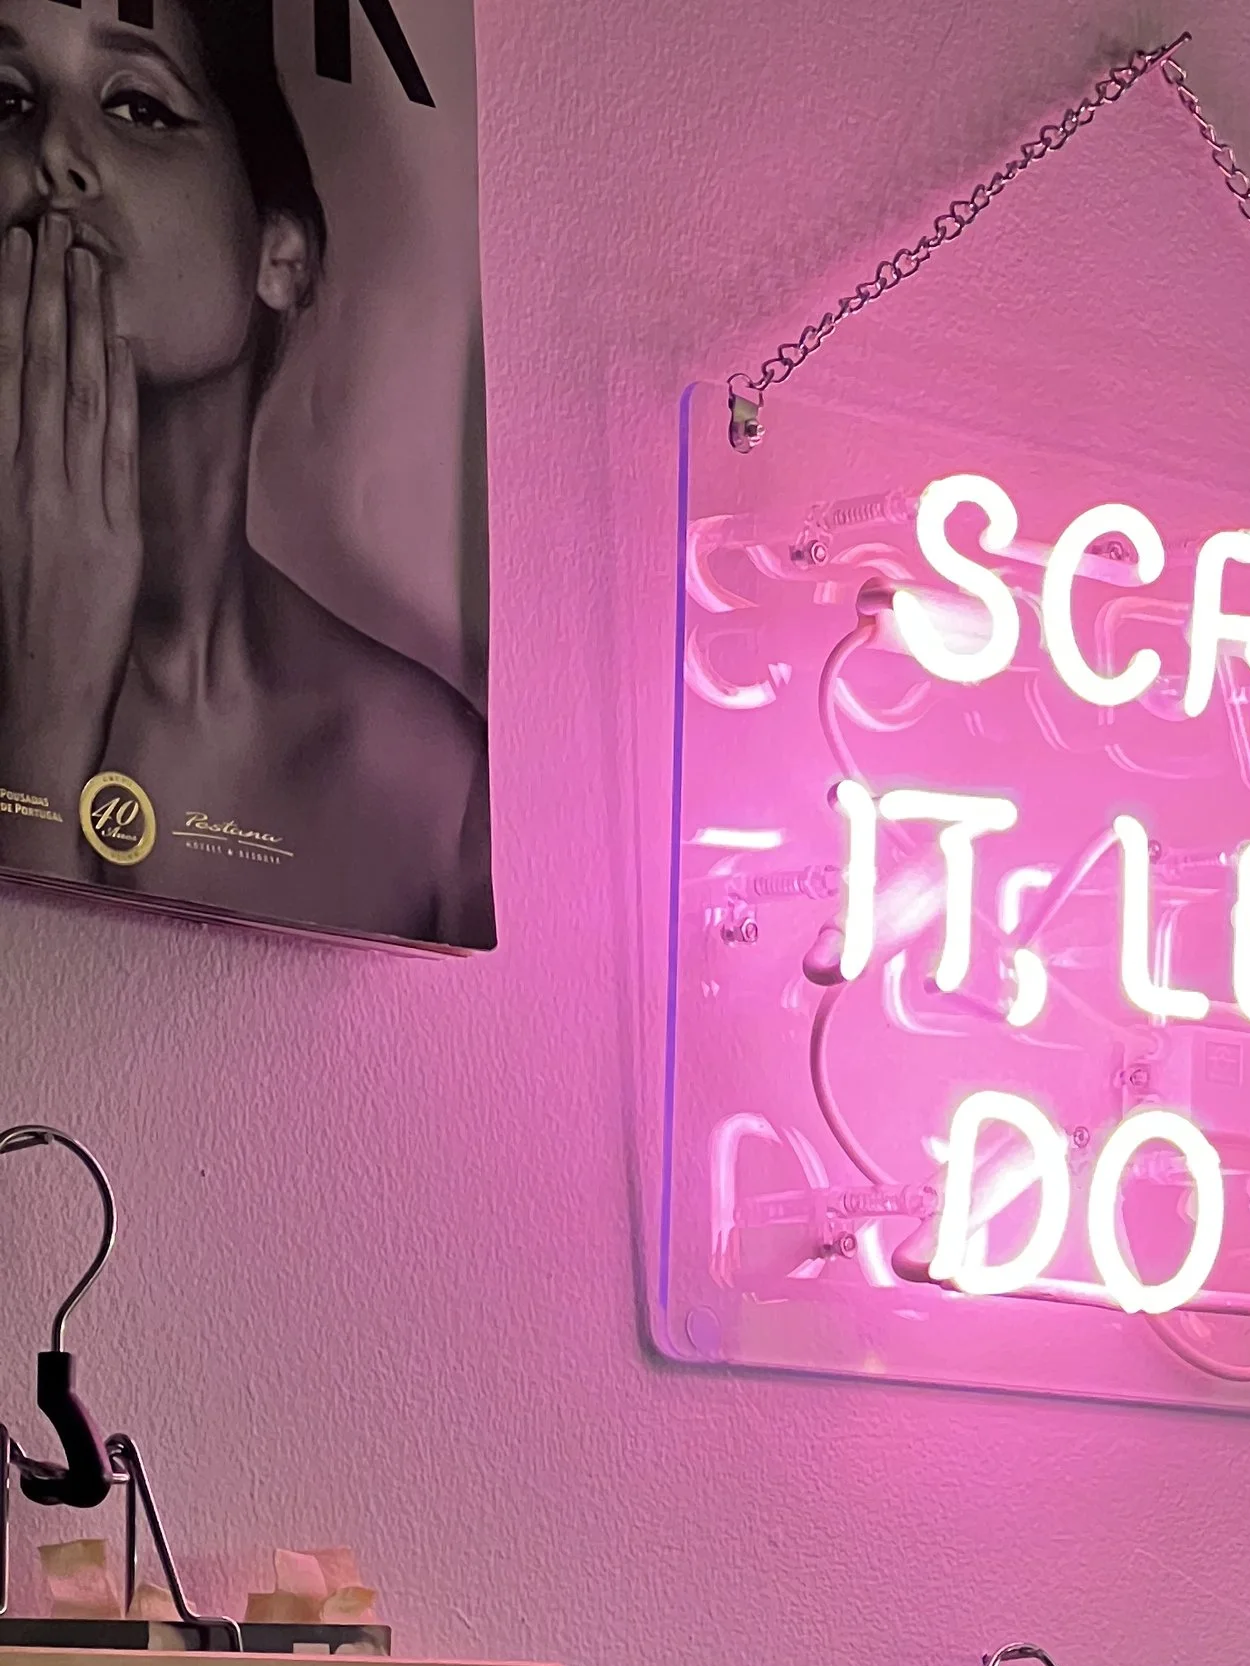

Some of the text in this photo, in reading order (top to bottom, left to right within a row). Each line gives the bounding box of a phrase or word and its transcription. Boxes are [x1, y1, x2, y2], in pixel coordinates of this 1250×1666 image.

[91, 797, 139, 830] 40
[185, 811, 284, 843] Pestana
[927, 1089, 1226, 1315] DO
